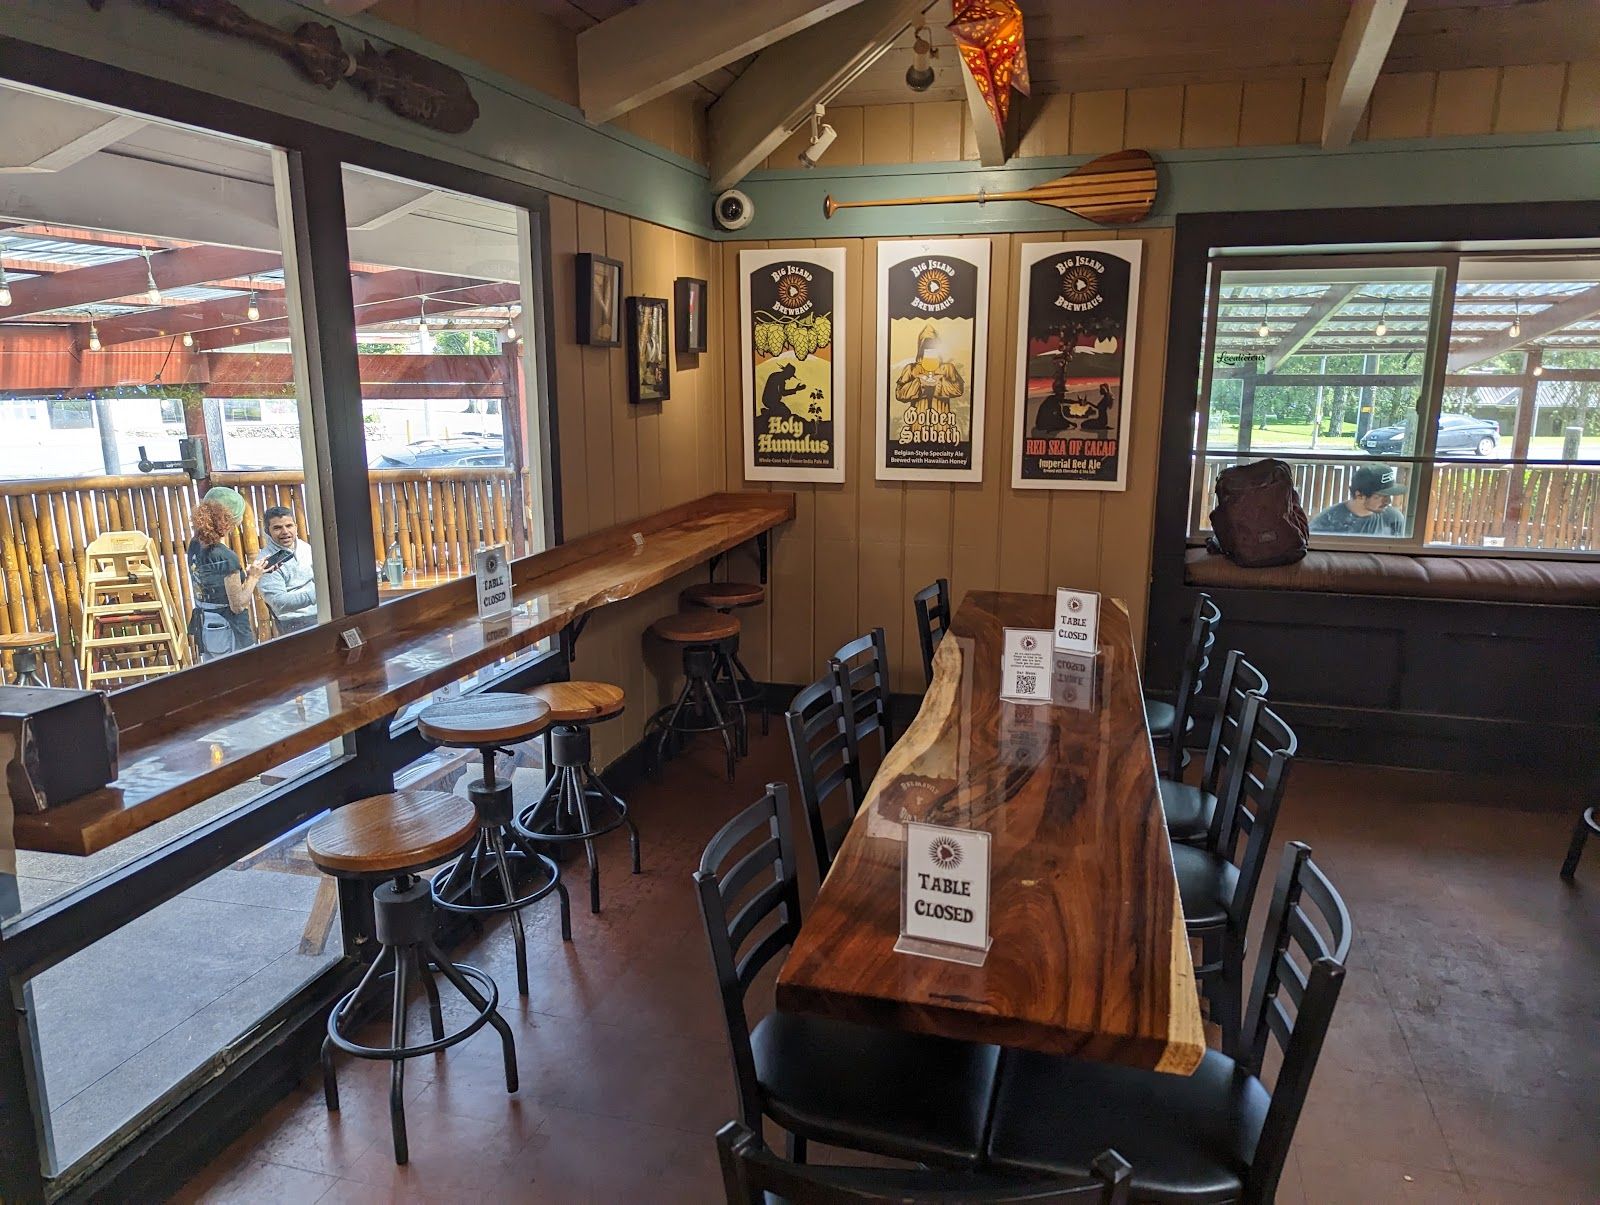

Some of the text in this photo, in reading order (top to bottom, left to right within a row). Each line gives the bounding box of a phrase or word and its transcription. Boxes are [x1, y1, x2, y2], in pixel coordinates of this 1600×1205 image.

[771, 265, 813, 282] BIG ISLAND
[910, 260, 955, 278] BIG ISLAND
[1056, 255, 1105, 275] BIG ISLAND
[772, 300, 813, 315] BREWHAUS
[910, 296, 954, 312] BREWHAUS
[1054, 294, 1103, 311] BREWHAUS
[904, 406, 956, 426] Golden
[768, 416, 803, 438] Holy
[758, 433, 829, 454] Humulus
[899, 426, 960, 446] Sabbath
[930, 450, 954, 458] Specialty
[1026, 439, 1116, 456] RED SEA OF CACAO
[1039, 458, 1101, 469] Imperial Red Ale
[483, 576, 503, 591] TABLE
[483, 592, 506, 607] CLOSED
[1060, 615, 1087, 627] TABLE
[1058, 629, 1088, 641] CLOSED
[918, 872, 971, 897] TABLE
[914, 899, 974, 923] CLOSED
